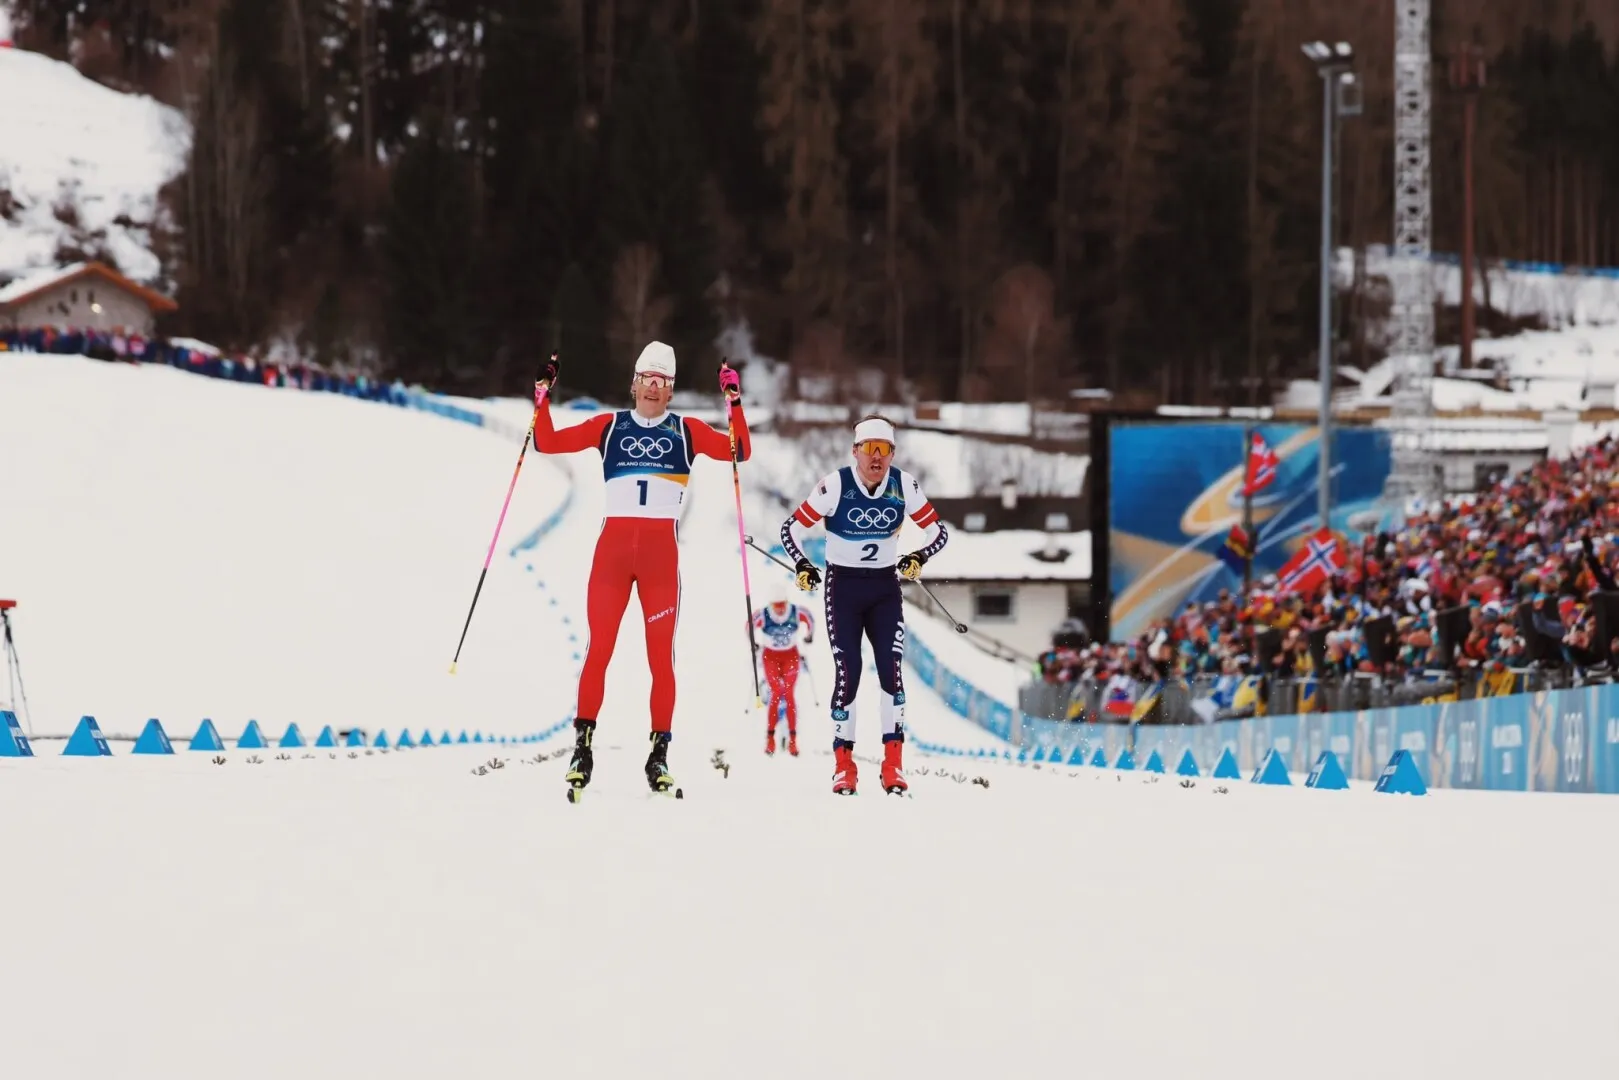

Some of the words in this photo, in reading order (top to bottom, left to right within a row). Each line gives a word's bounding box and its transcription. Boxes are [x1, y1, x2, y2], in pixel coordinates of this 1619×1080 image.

[637, 480, 648, 506] 1
[860, 543, 879, 561] 2
[648, 609, 669, 623] CRAFT
[835, 723, 842, 733] 2
